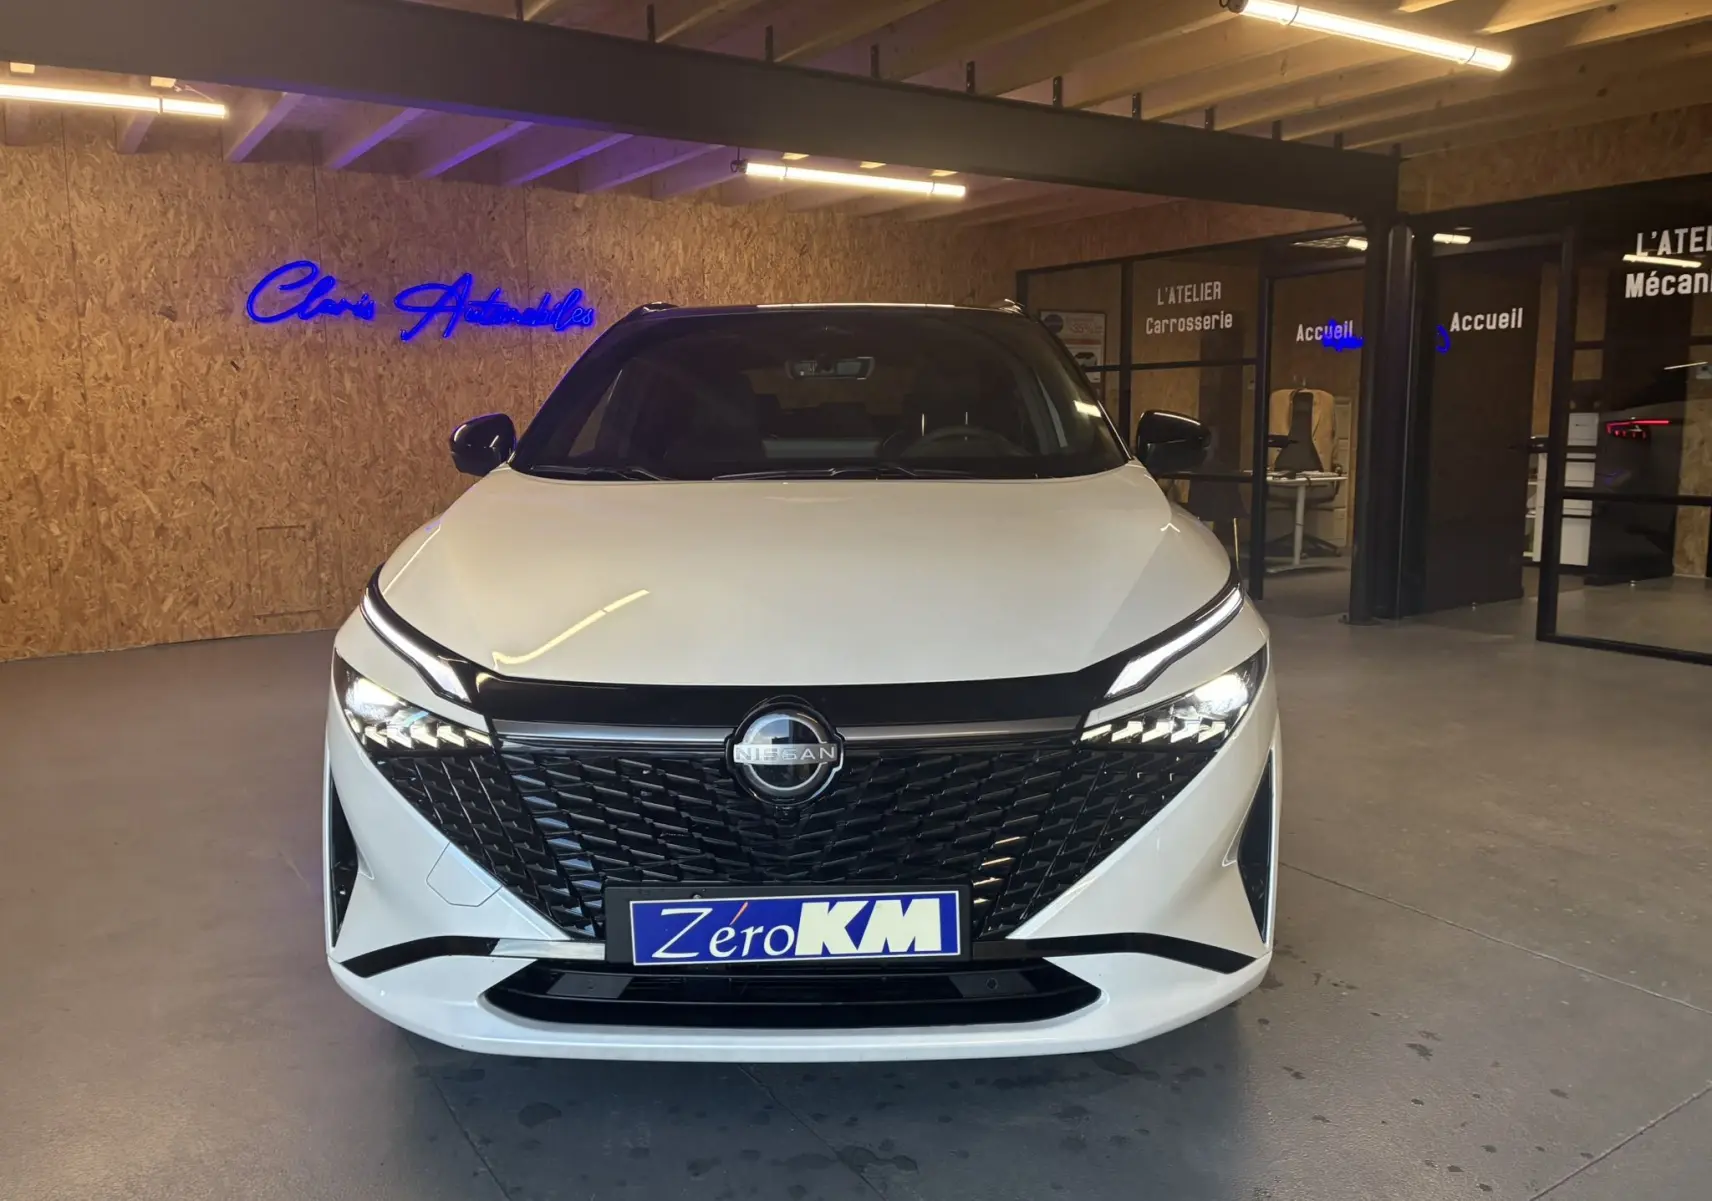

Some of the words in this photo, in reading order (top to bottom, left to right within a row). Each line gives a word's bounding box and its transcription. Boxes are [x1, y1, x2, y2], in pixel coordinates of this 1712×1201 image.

[1157, 281, 1222, 305] L'ATELIER
[1625, 271, 1712, 298] Mécan
[394, 273, 595, 341] Automobiles
[1450, 307, 1523, 332] Accueil
[1145, 310, 1233, 335] Carrosserie
[1296, 320, 1353, 342] Accueil
[735, 746, 836, 761] NISSAN
